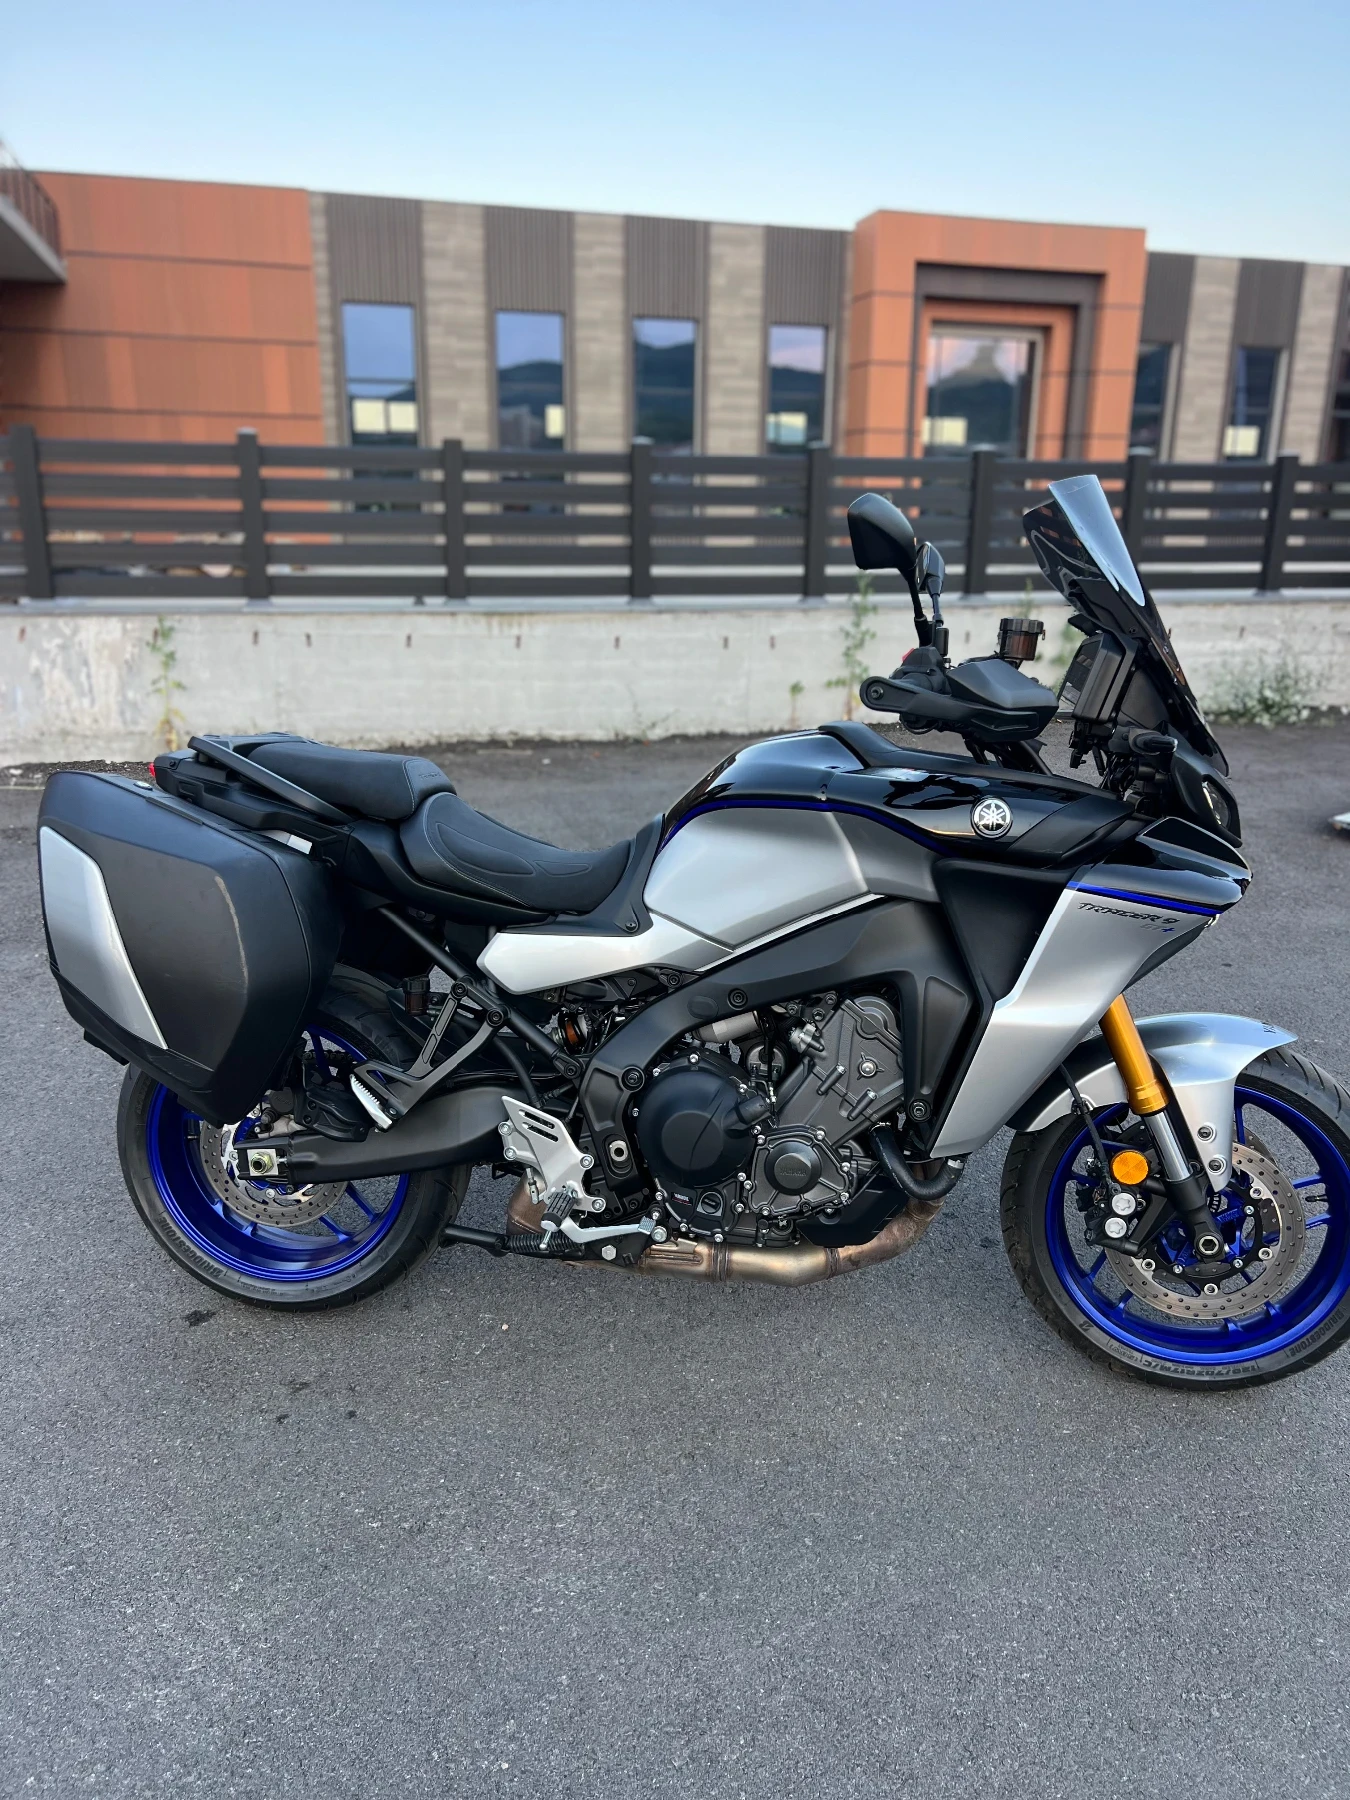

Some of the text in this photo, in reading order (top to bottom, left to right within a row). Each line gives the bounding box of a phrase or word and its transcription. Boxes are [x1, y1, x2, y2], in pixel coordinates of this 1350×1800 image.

[1077, 902, 1180, 925] TRACER 9
[160, 1216, 225, 1279] BRIDGESTONE
[1288, 1308, 1345, 1357] BRIDGESTONE
